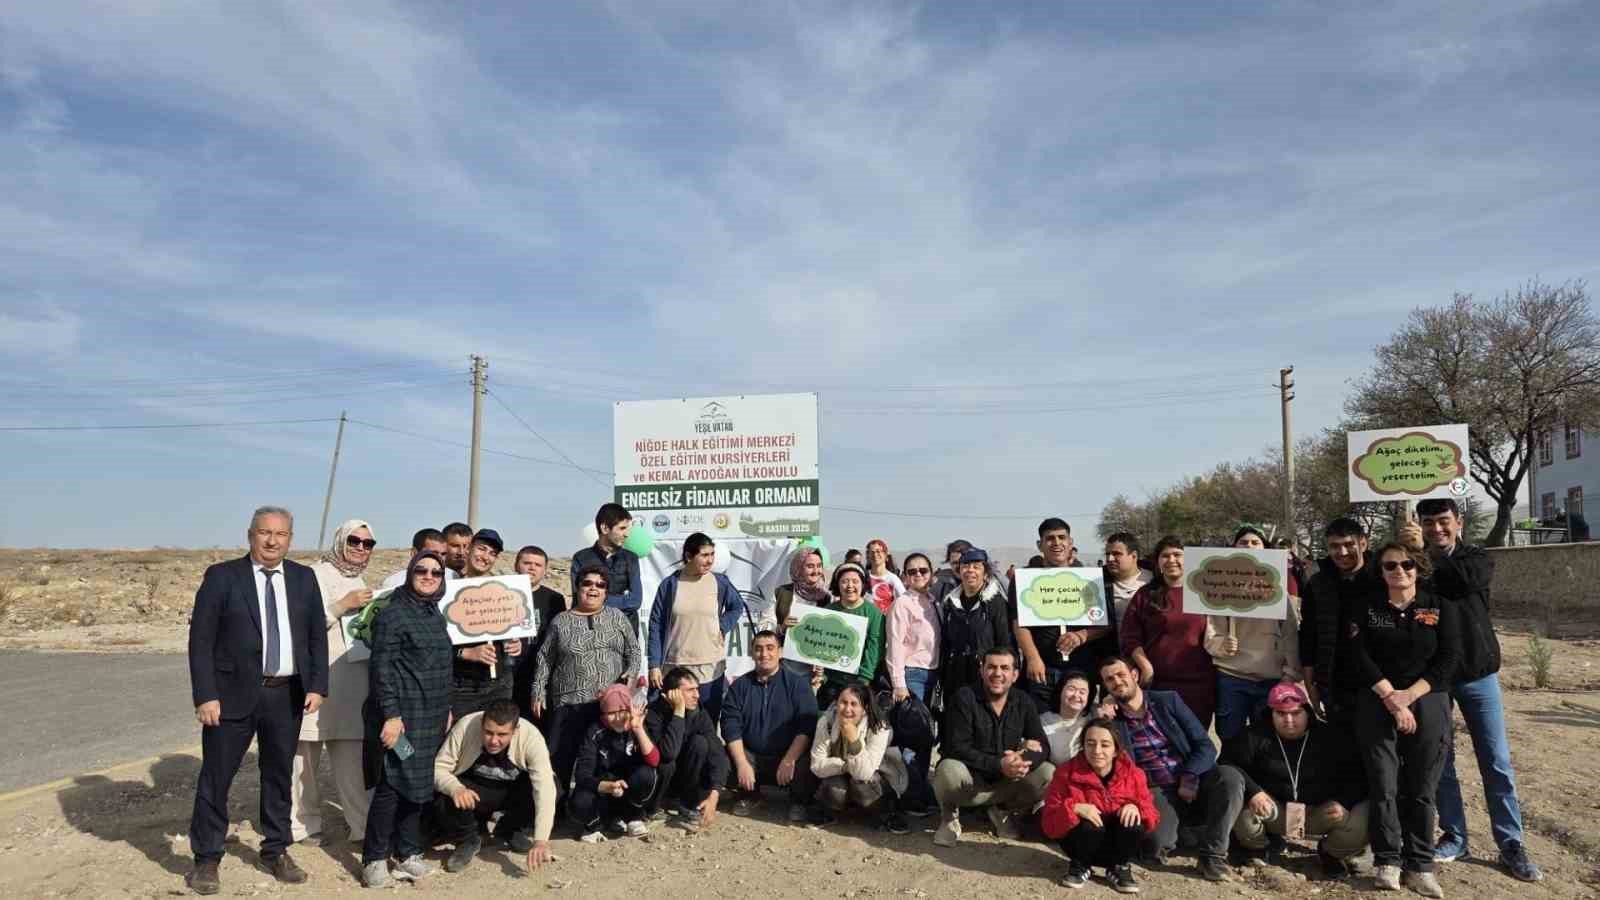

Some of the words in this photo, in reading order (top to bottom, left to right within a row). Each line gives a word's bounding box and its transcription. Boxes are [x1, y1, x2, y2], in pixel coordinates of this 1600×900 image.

[712, 422, 733, 433] VATAN
[635, 439, 668, 452] NİĞDE
[671, 437, 699, 451] HALK
[702, 434, 744, 449] EĞİTİMİ
[746, 432, 796, 448] MERKEZİ
[1376, 447, 1401, 456] Ağaç
[640, 454, 667, 468] ÖZEL
[670, 451, 708, 466] EĞİTİM
[710, 448, 791, 465] KURSİYERLERİ
[633, 473, 646, 483] ve
[648, 469, 685, 482] KEMAL
[687, 466, 739, 481] AYDOĞAN
[743, 464, 798, 479] İLKOKULU
[621, 486, 682, 508] ENGELSİZ
[686, 485, 750, 506] FİDANLAR
[755, 486, 812, 505] ORMANI
